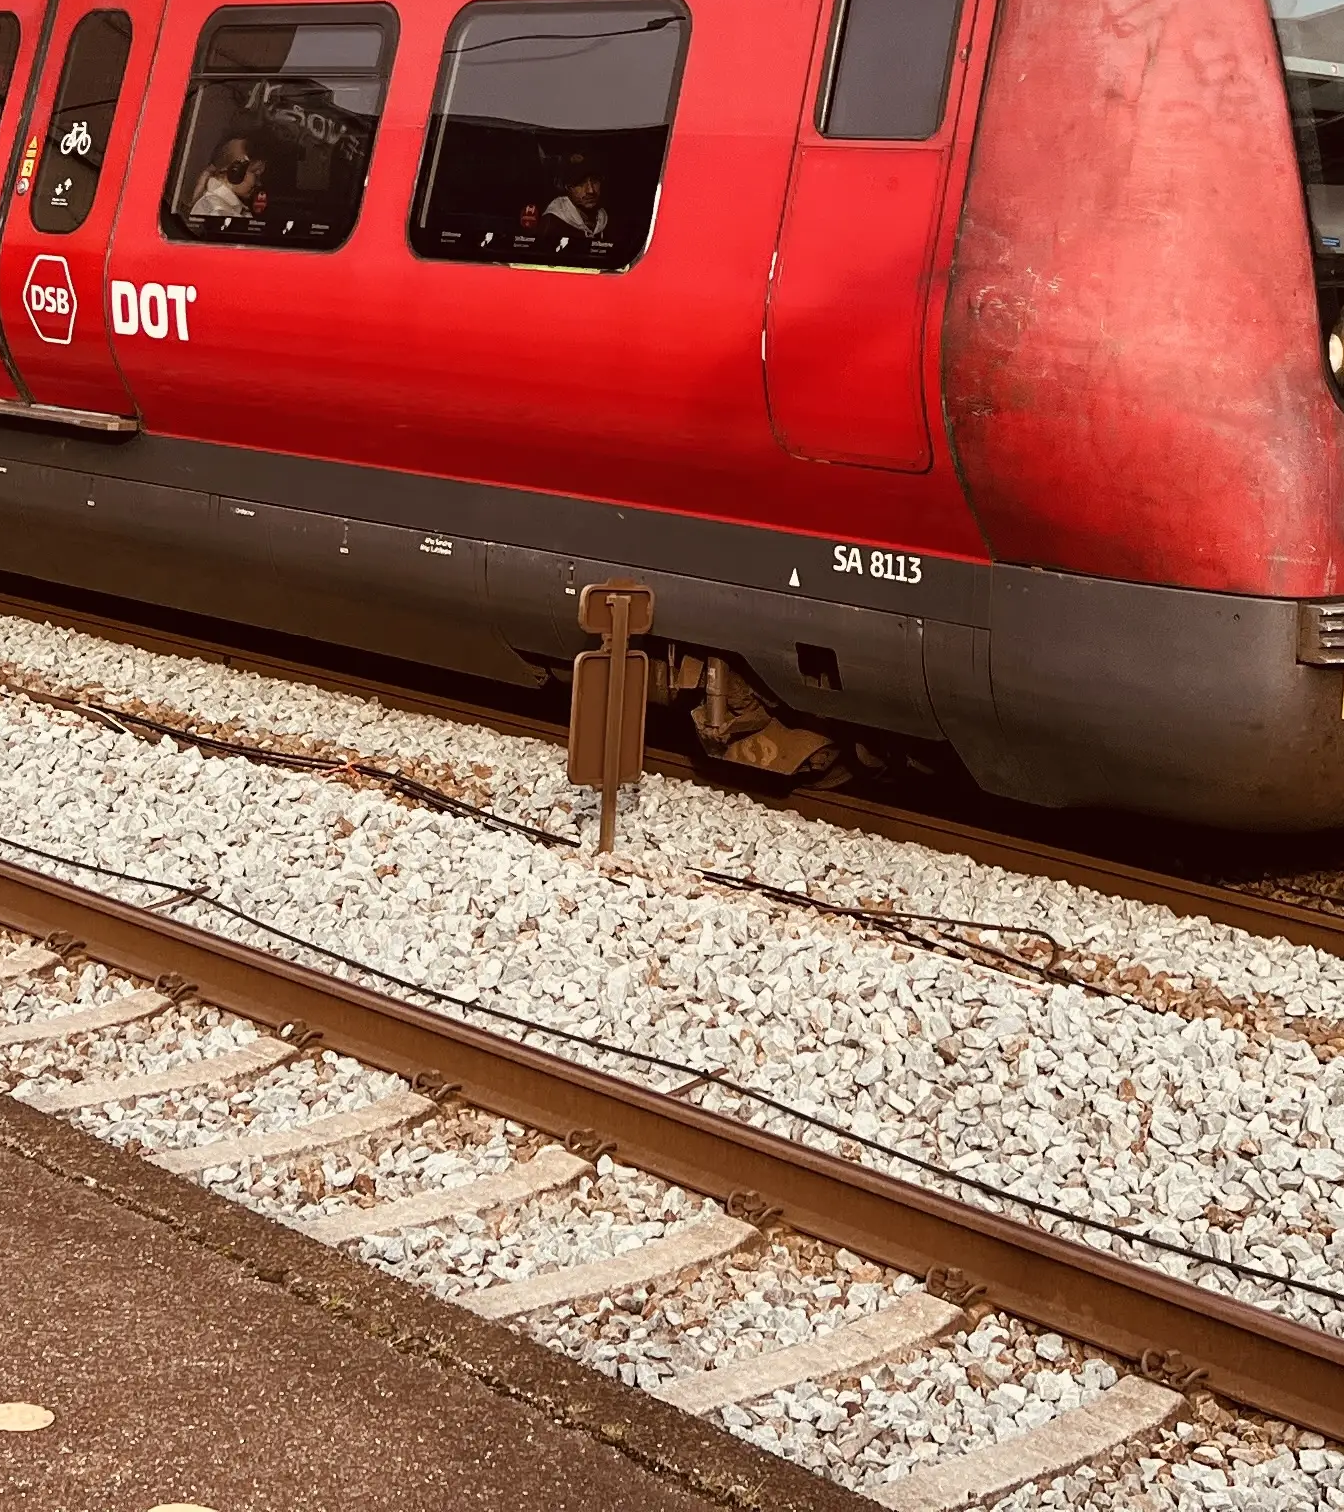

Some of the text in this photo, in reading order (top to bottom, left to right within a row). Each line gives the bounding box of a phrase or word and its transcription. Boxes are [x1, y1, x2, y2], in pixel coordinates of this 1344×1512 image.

[30, 284, 70, 315] DSB
[111, 280, 197, 341] DOT
[832, 545, 922, 584] SA 8113
